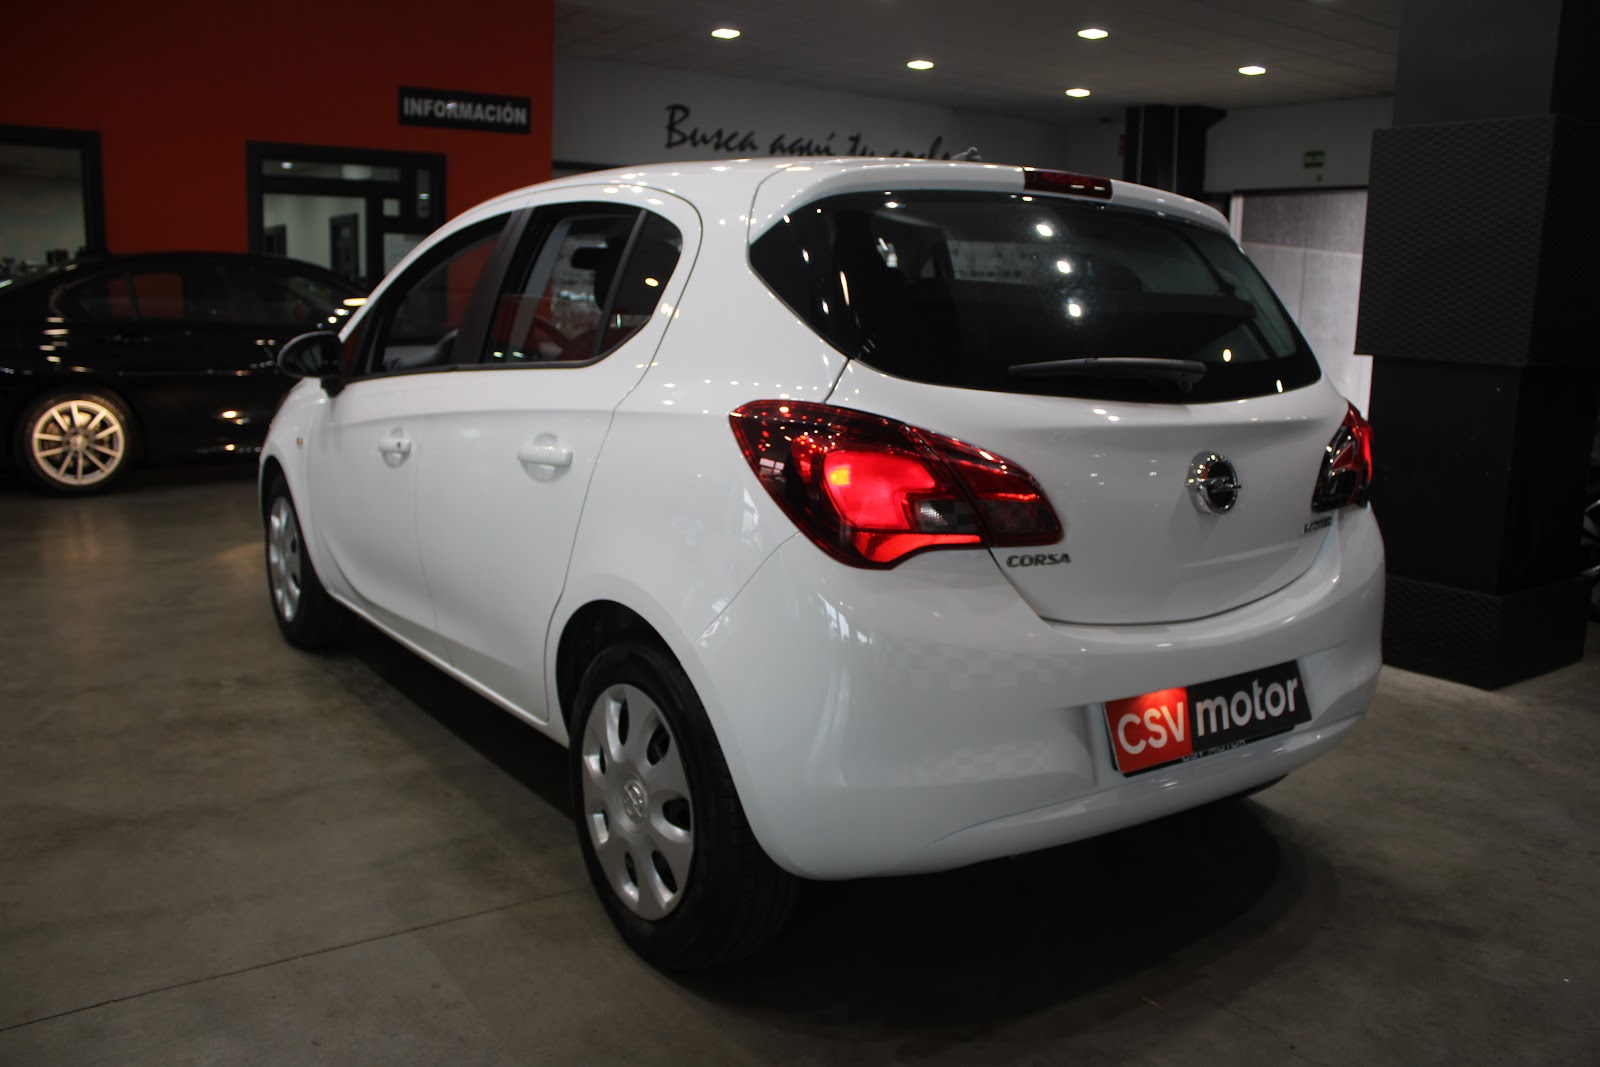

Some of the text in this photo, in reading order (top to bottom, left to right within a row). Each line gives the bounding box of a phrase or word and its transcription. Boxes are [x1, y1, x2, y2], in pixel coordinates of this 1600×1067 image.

[402, 98, 528, 125] INFORMACIÓN
[665, 103, 758, 152] Busca
[1006, 552, 1072, 568] CORSA
[1117, 677, 1298, 755] CSV motor
